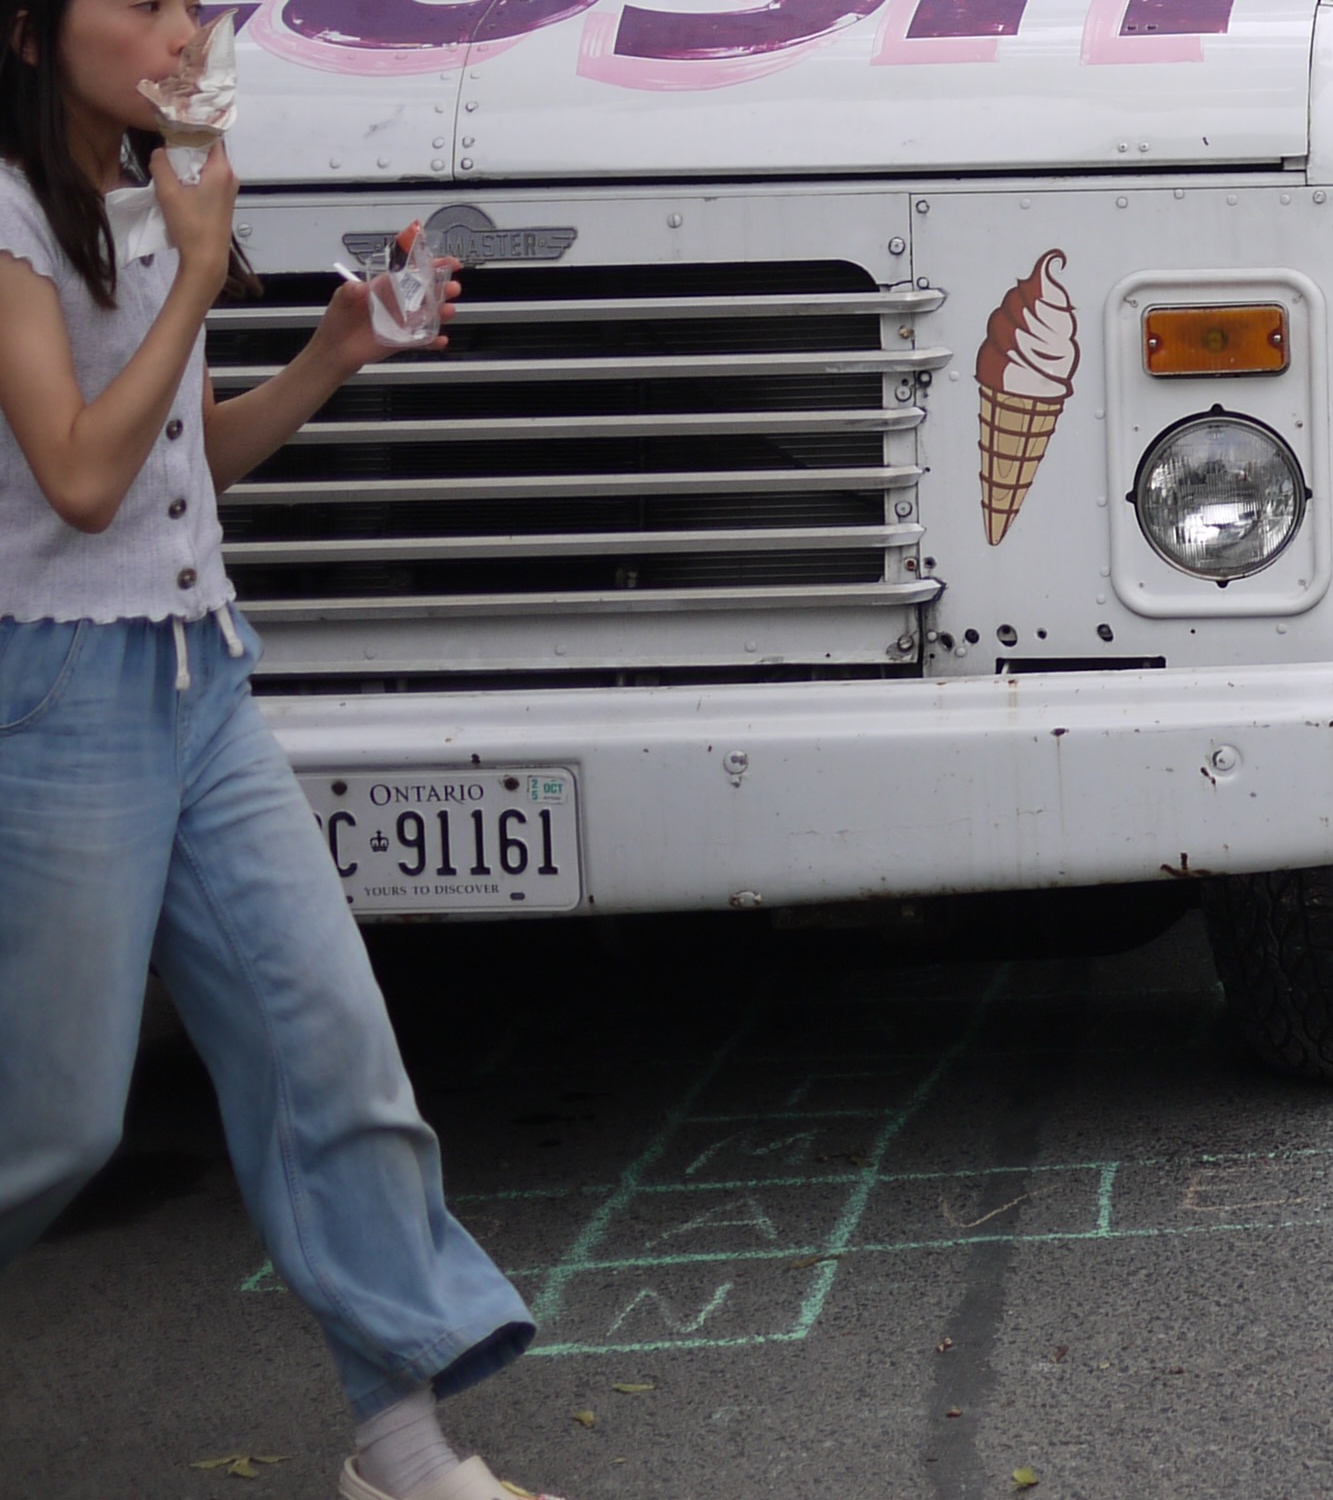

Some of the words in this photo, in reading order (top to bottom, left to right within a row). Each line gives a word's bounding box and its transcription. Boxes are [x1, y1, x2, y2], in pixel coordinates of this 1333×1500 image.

[543, 782, 563, 794] OCT
[395, 808, 560, 877] 91161
[364, 885, 408, 898] YOURS
[413, 885, 430, 896] TO
[434, 883, 500, 896] DISCOVER
